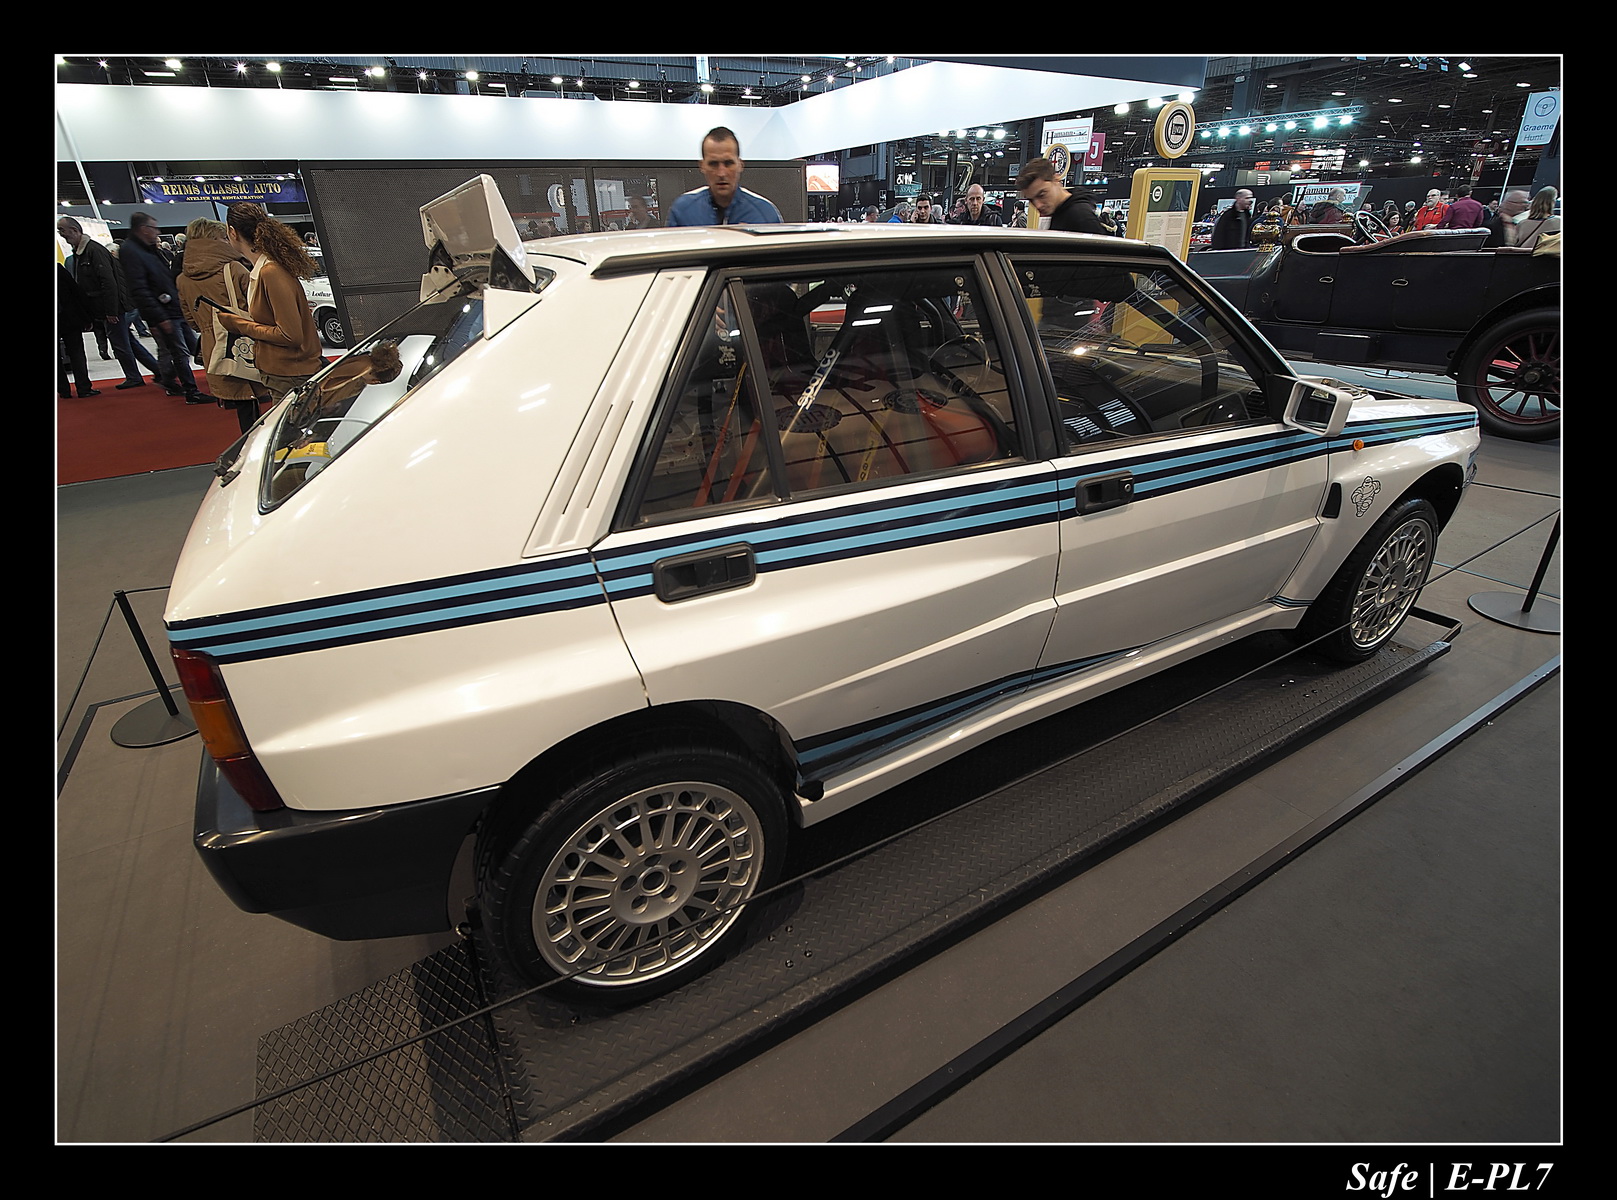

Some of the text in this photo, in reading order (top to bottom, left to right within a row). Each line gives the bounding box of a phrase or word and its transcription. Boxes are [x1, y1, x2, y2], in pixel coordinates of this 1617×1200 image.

[1523, 124, 1554, 132] Graeme
[1090, 141, 1100, 159] J
[161, 182, 282, 196] REIMS CLASSIC AUTO
[797, 349, 836, 407] sparco
